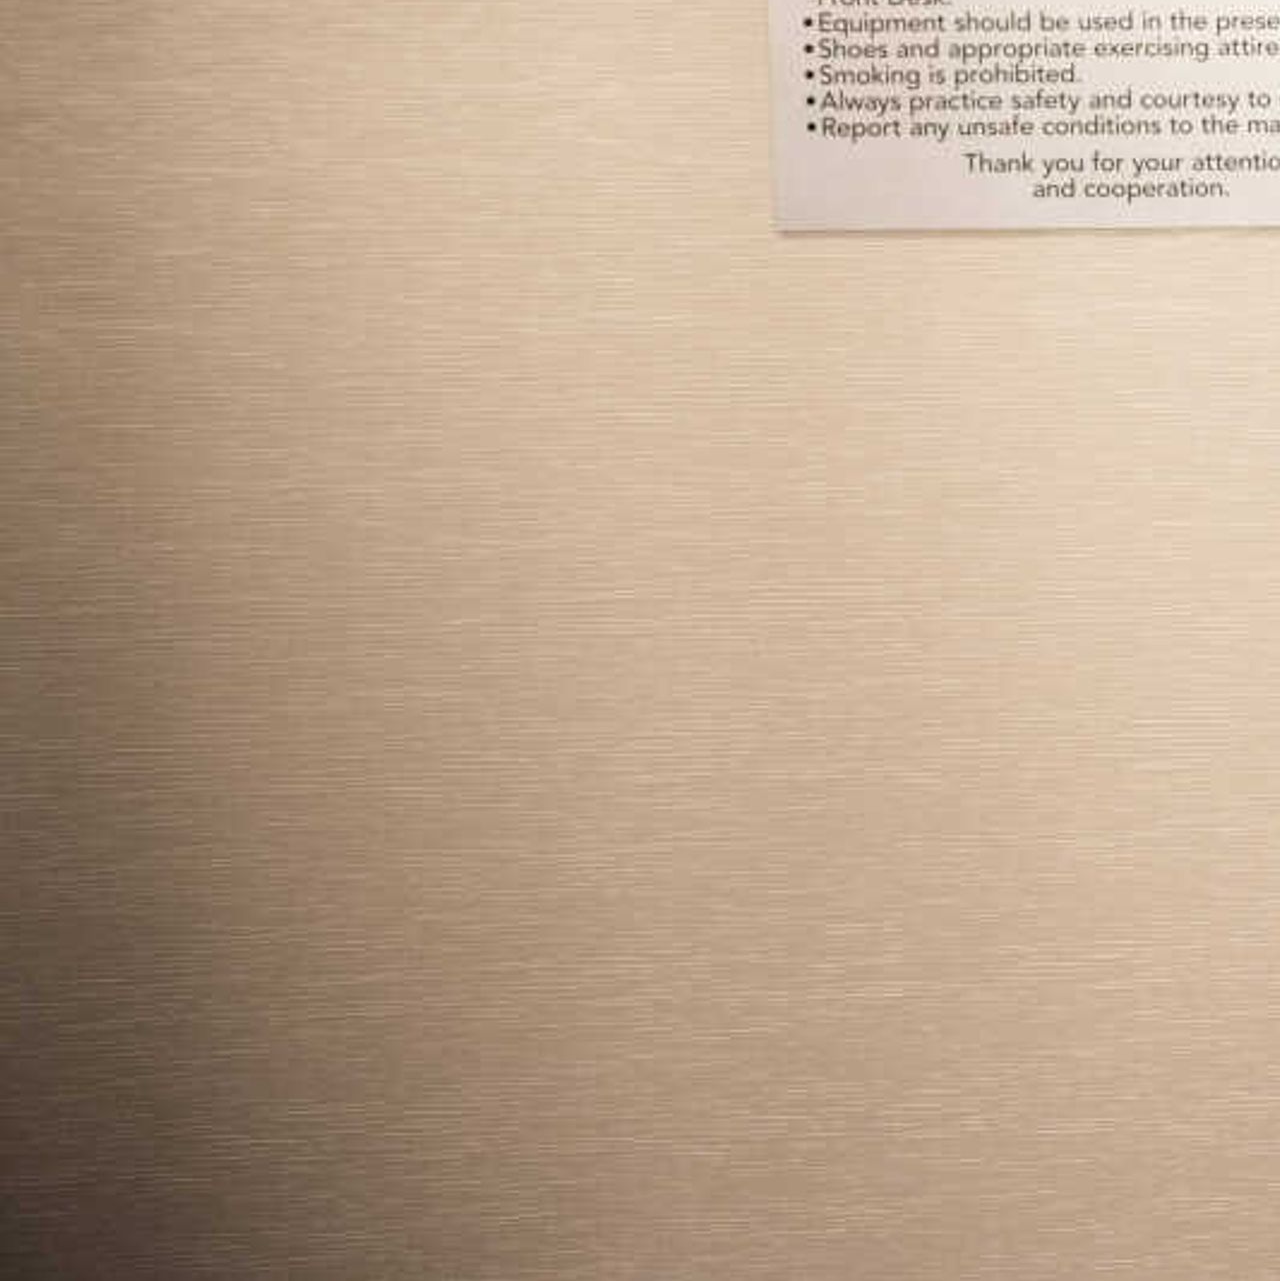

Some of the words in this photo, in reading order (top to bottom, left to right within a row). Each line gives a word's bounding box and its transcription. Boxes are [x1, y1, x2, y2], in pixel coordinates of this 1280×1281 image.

[817, 8, 947, 36] Equipment
[953, 8, 1032, 31] should
[1039, 8, 1070, 31] be
[1077, 8, 1134, 31] used
[1142, 8, 1163, 31] in
[1169, 8, 1209, 31] the
[817, 34, 889, 57] Shoes
[895, 34, 940, 57] and
[947, 34, 1087, 62] appropriate
[1093, 34, 1210, 62] exercising
[1217, 34, 1280, 57] attire
[818, 61, 922, 89] Smoking
[927, 61, 947, 84] is
[953, 61, 1083, 89] prohibited.
[819, 86, 902, 114] Always
[908, 86, 1004, 114] practice
[1010, 86, 1083, 114] safety
[1088, 86, 1132, 109] and
[1139, 86, 1241, 114] courtesy
[1247, 86, 1272, 109] to
[821, 112, 902, 141] Report
[909, 119, 950, 141] any
[957, 112, 1036, 136] unsafe
[1040, 112, 1163, 136] conditions
[1168, 112, 1194, 136] to
[1200, 112, 1241, 136] the
[965, 149, 1034, 171] Thank
[1041, 156, 1085, 176] you
[1091, 149, 1125, 171] for
[1131, 156, 1185, 176] your
[1032, 175, 1077, 197] and
[1082, 175, 1230, 202] cooperation.
